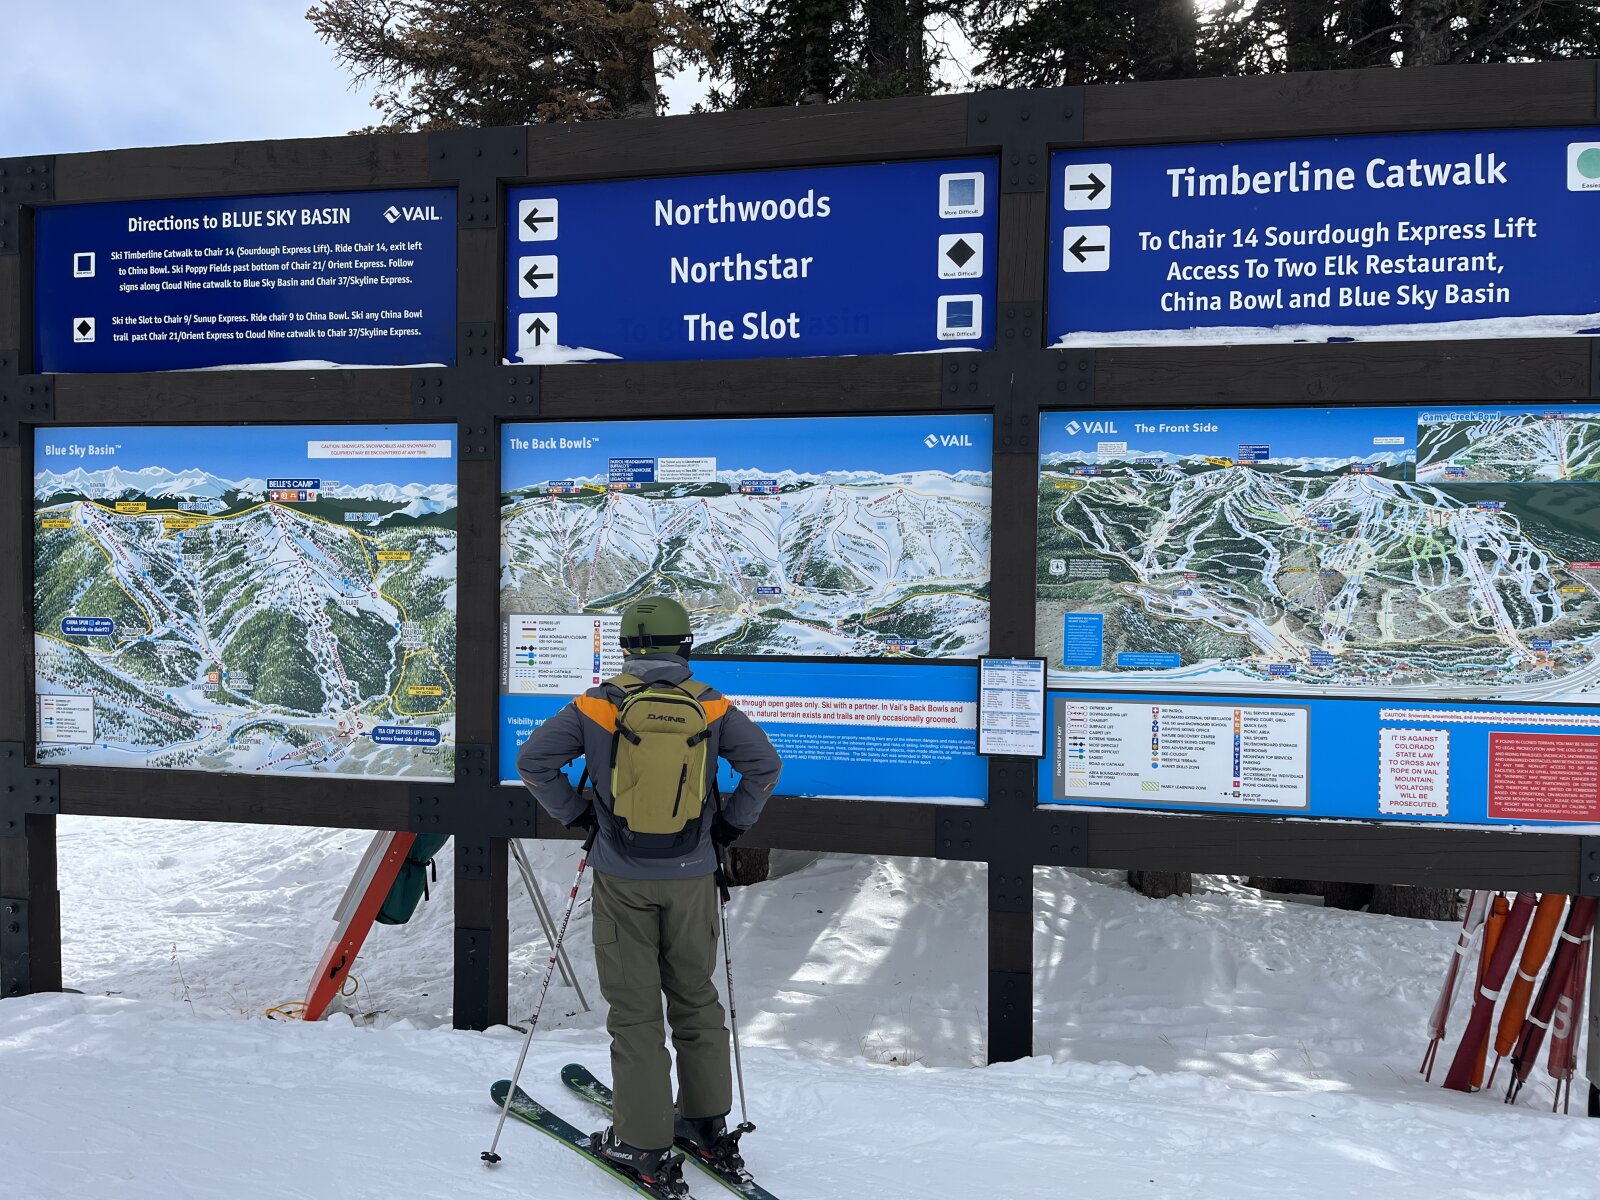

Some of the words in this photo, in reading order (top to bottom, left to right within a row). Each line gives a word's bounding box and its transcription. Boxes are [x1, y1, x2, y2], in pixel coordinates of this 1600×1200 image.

[1167, 162, 1355, 196] Timberline
[1366, 154, 1508, 188] Catwalk
[402, 206, 439, 220] VAIL
[656, 190, 830, 225] Northwoods
[129, 216, 199, 232] Directions
[203, 215, 218, 229] to
[222, 211, 262, 228] BLUE
[266, 210, 297, 226] SKY
[302, 208, 350, 225] BASIN
[1139, 232, 1162, 250] To
[1168, 229, 1226, 250] Chair
[1232, 228, 1258, 247] 14
[1265, 222, 1389, 247] Sourdough
[1398, 222, 1486, 245] Express
[1494, 217, 1536, 238] Lift
[111, 252, 122, 260] Ski
[124, 250, 162, 259] Timberline
[164, 249, 193, 258] Catwalk
[204, 248, 223, 256] Chair
[225, 248, 234, 256] 14
[237, 246, 280, 258] (Sourdough
[282, 246, 311, 255] Express
[313, 244, 333, 255] Lift).
[335, 244, 352, 252] Ride
[354, 243, 374, 252] Chair
[376, 243, 388, 252] 14,
[390, 242, 406, 251] exit
[408, 241, 422, 250] left
[128, 267, 148, 275] China
[150, 266, 170, 274] Bowl.
[172, 265, 183, 274] Ski
[186, 265, 208, 275] Poppy
[210, 264, 232, 272] Fields
[233, 264, 250, 273] past
[252, 263, 279, 271] bottom
[281, 261, 290, 270] of
[291, 261, 311, 270] Chair
[313, 260, 326, 272] 21/
[328, 260, 353, 269] Orient
[355, 260, 386, 270] Express.
[389, 258, 414, 267] Follow
[671, 254, 813, 283] Northstar
[1167, 262, 1239, 280] Access
[1245, 259, 1268, 278] To
[1274, 258, 1317, 277] Two
[1325, 255, 1359, 276] Elk
[1366, 253, 1504, 274] Restaurant,
[120, 283, 138, 293] signs
[140, 282, 160, 292] along
[162, 281, 182, 290] Cloud
[184, 281, 201, 289] Nine
[203, 280, 232, 288] catwalk
[244, 279, 260, 288] Blue
[262, 278, 276, 289] Sky
[277, 278, 298, 286] Basin
[300, 277, 314, 286] and
[316, 277, 336, 286] Chair
[338, 276, 378, 287] 37/Skyline
[380, 276, 412, 286] Express.
[1161, 292, 1221, 311] China
[1230, 289, 1283, 310] Bowl
[1289, 288, 1330, 308] and
[1339, 286, 1390, 306] Blue
[1397, 285, 1438, 308] Sky
[1446, 283, 1509, 304] Basin
[112, 317, 123, 325] Ski
[125, 316, 137, 324] the
[138, 316, 153, 324] Slot
[164, 315, 182, 324] Chair
[184, 314, 192, 326] 9/
[194, 315, 217, 324] Sunup
[219, 314, 249, 324] Express.
[251, 313, 267, 322] Ride
[269, 313, 288, 321] chair
[289, 313, 294, 321] 9
[306, 312, 327, 320] China
[329, 311, 350, 320] Bowl.
[352, 311, 364, 320] Ski
[365, 313, 379, 321] any
[381, 310, 402, 319] China
[404, 310, 423, 318] Bowl
[684, 314, 734, 341] The
[742, 312, 800, 340] Slot
[1422, 413, 1447, 422] Game
[1450, 412, 1476, 420] Creek
[1478, 411, 1500, 420] Bowl
[1083, 422, 1118, 433] VAIL
[1135, 424, 1156, 433] The
[1159, 424, 1190, 432] Front
[1193, 423, 1218, 432] Side
[510, 438, 529, 449] The
[532, 438, 556, 449] Back
[940, 435, 972, 446] VAIL
[46, 445, 66, 455] Blue
[69, 445, 86, 458] Sky
[742, 700, 766, 708] through
[508, 718, 534, 726] Visibility
[866, 714, 880, 722] only
[882, 715, 924, 723] occasionally
